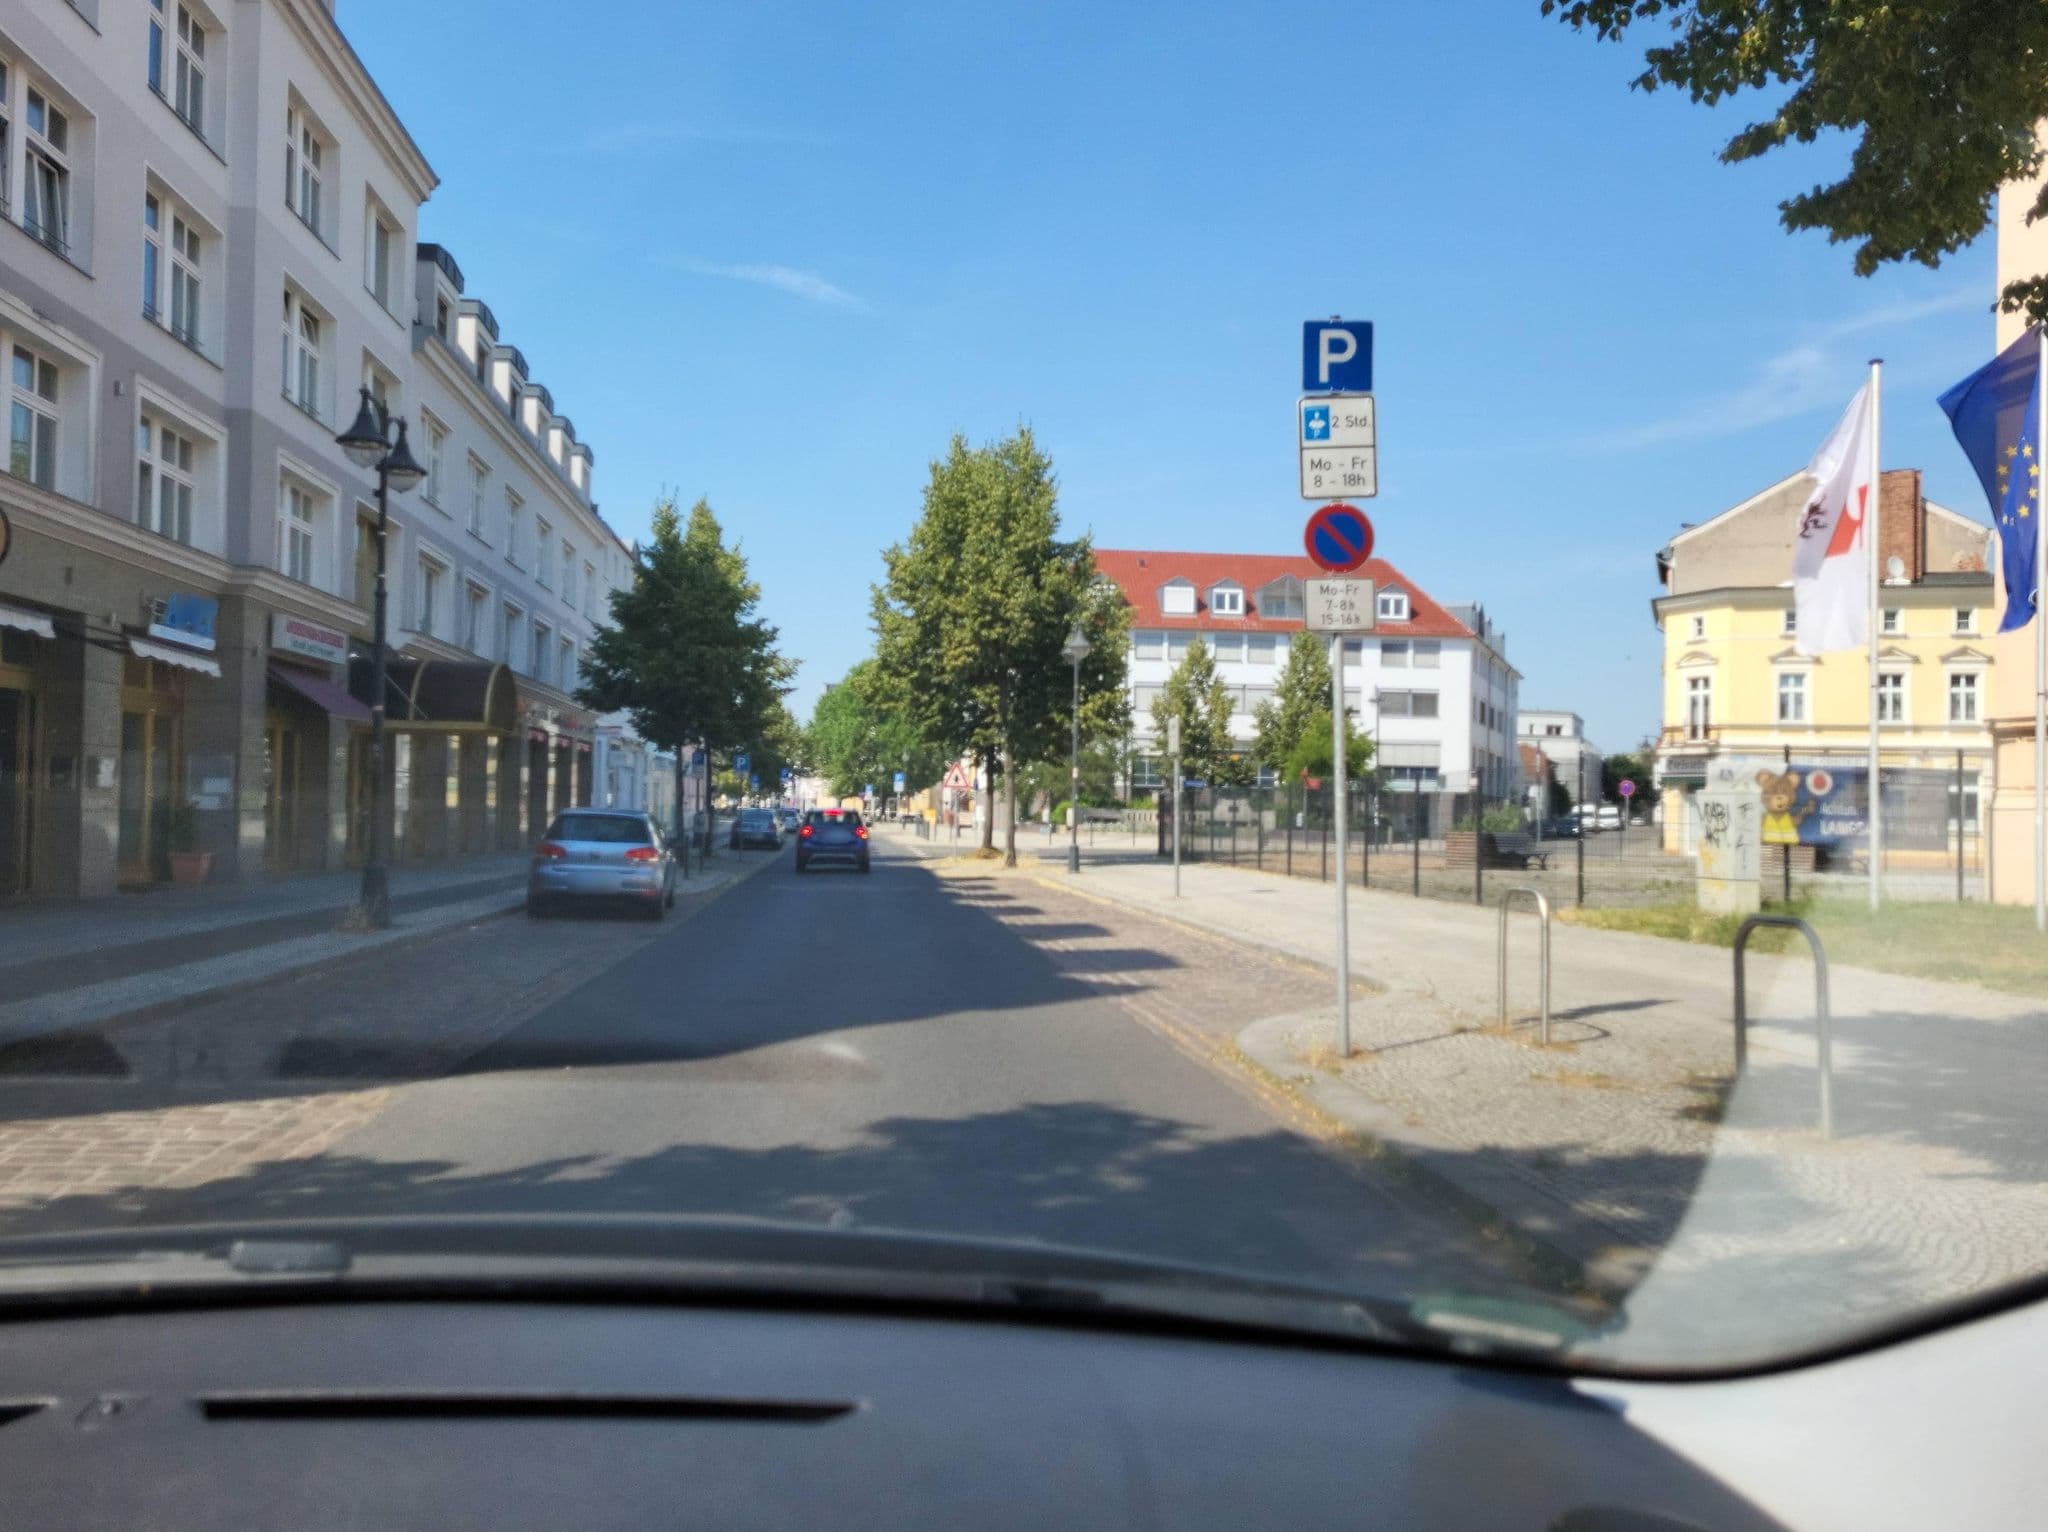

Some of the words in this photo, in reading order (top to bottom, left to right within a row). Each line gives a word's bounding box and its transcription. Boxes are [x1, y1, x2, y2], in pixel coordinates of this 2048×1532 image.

[1319, 328, 1357, 383] P
[1332, 416, 1340, 428] 2
[1310, 458, 1332, 471] Mo
[1352, 456, 1367, 470] Fr
[1313, 475, 1322, 488] 8
[1342, 473, 1366, 487] 18h
